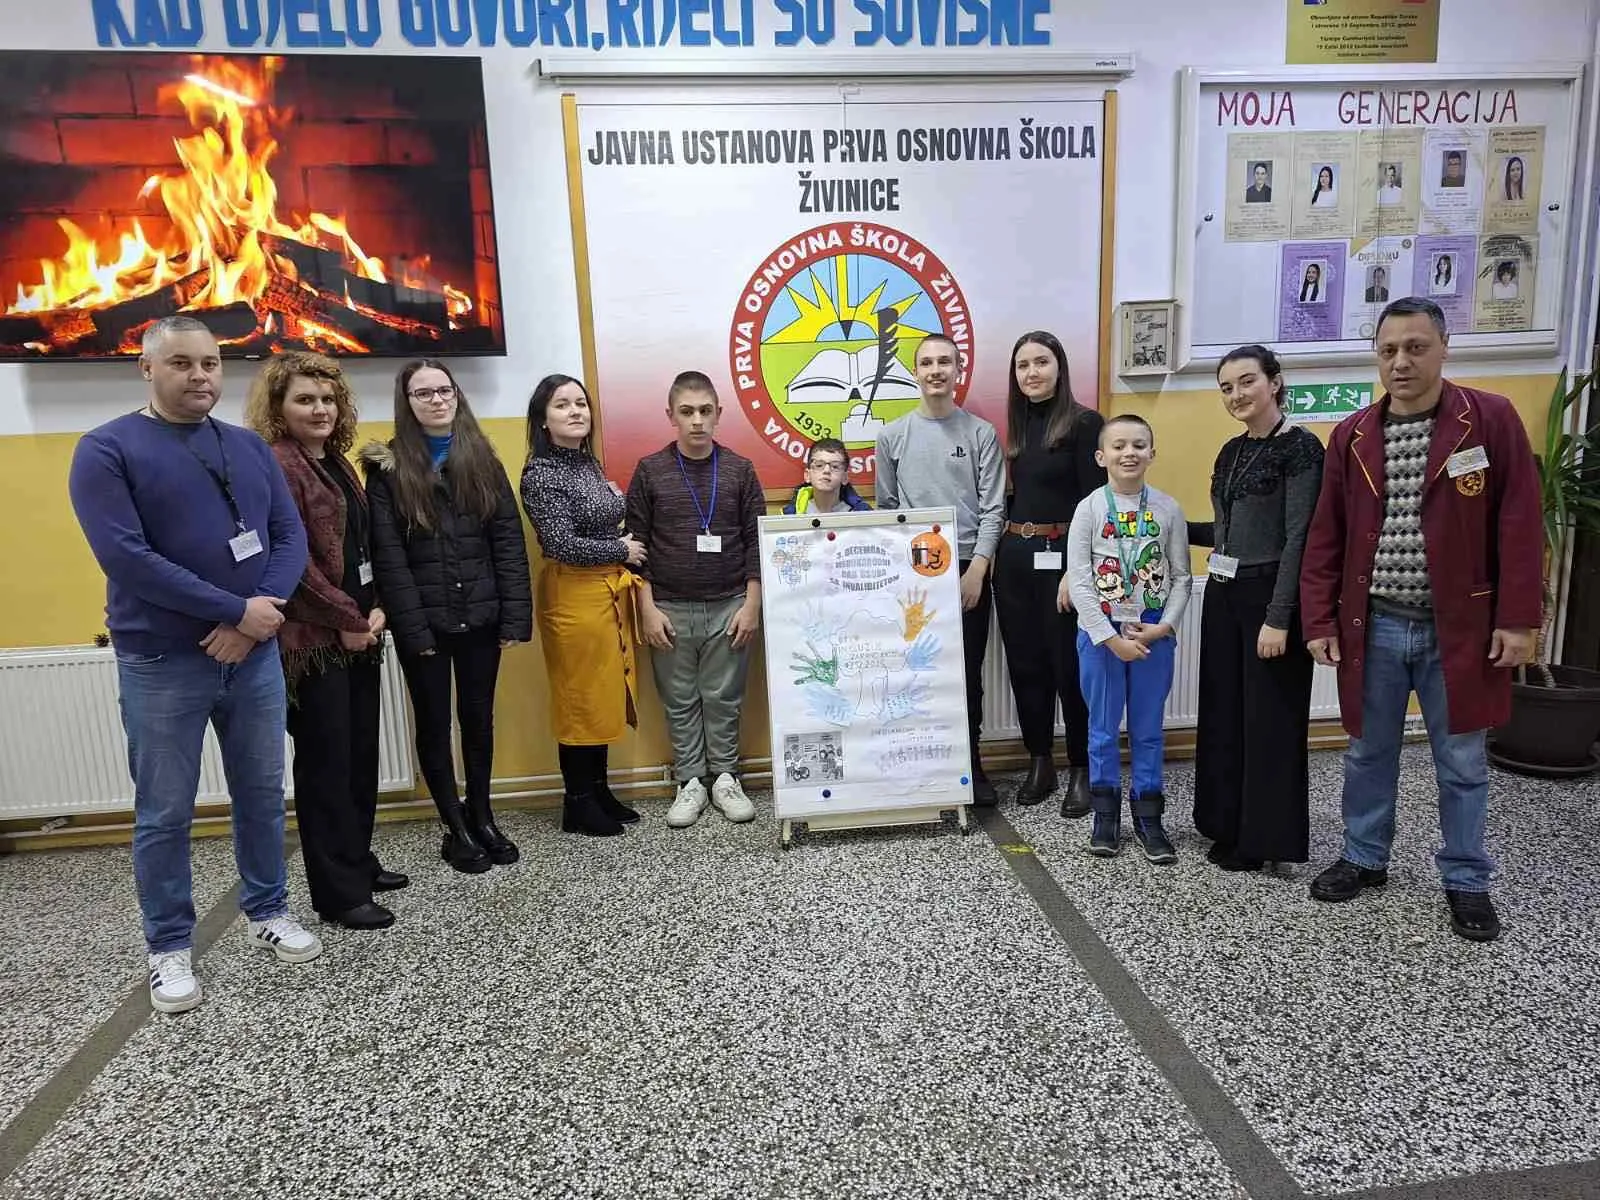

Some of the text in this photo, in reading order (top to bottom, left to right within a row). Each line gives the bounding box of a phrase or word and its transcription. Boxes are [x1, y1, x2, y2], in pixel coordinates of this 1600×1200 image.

[1218, 90, 1518, 126] MOJA GENERACIJA
[588, 118, 1096, 165] JAVNA USTANOVA PRVA OSNOVNA ŠKOLA
[798, 171, 900, 213] ŽIVINICE
[745, 228, 843, 313] OSNOVNA
[850, 223, 927, 272] ŠKOLA
[736, 319, 755, 390] PRVA
